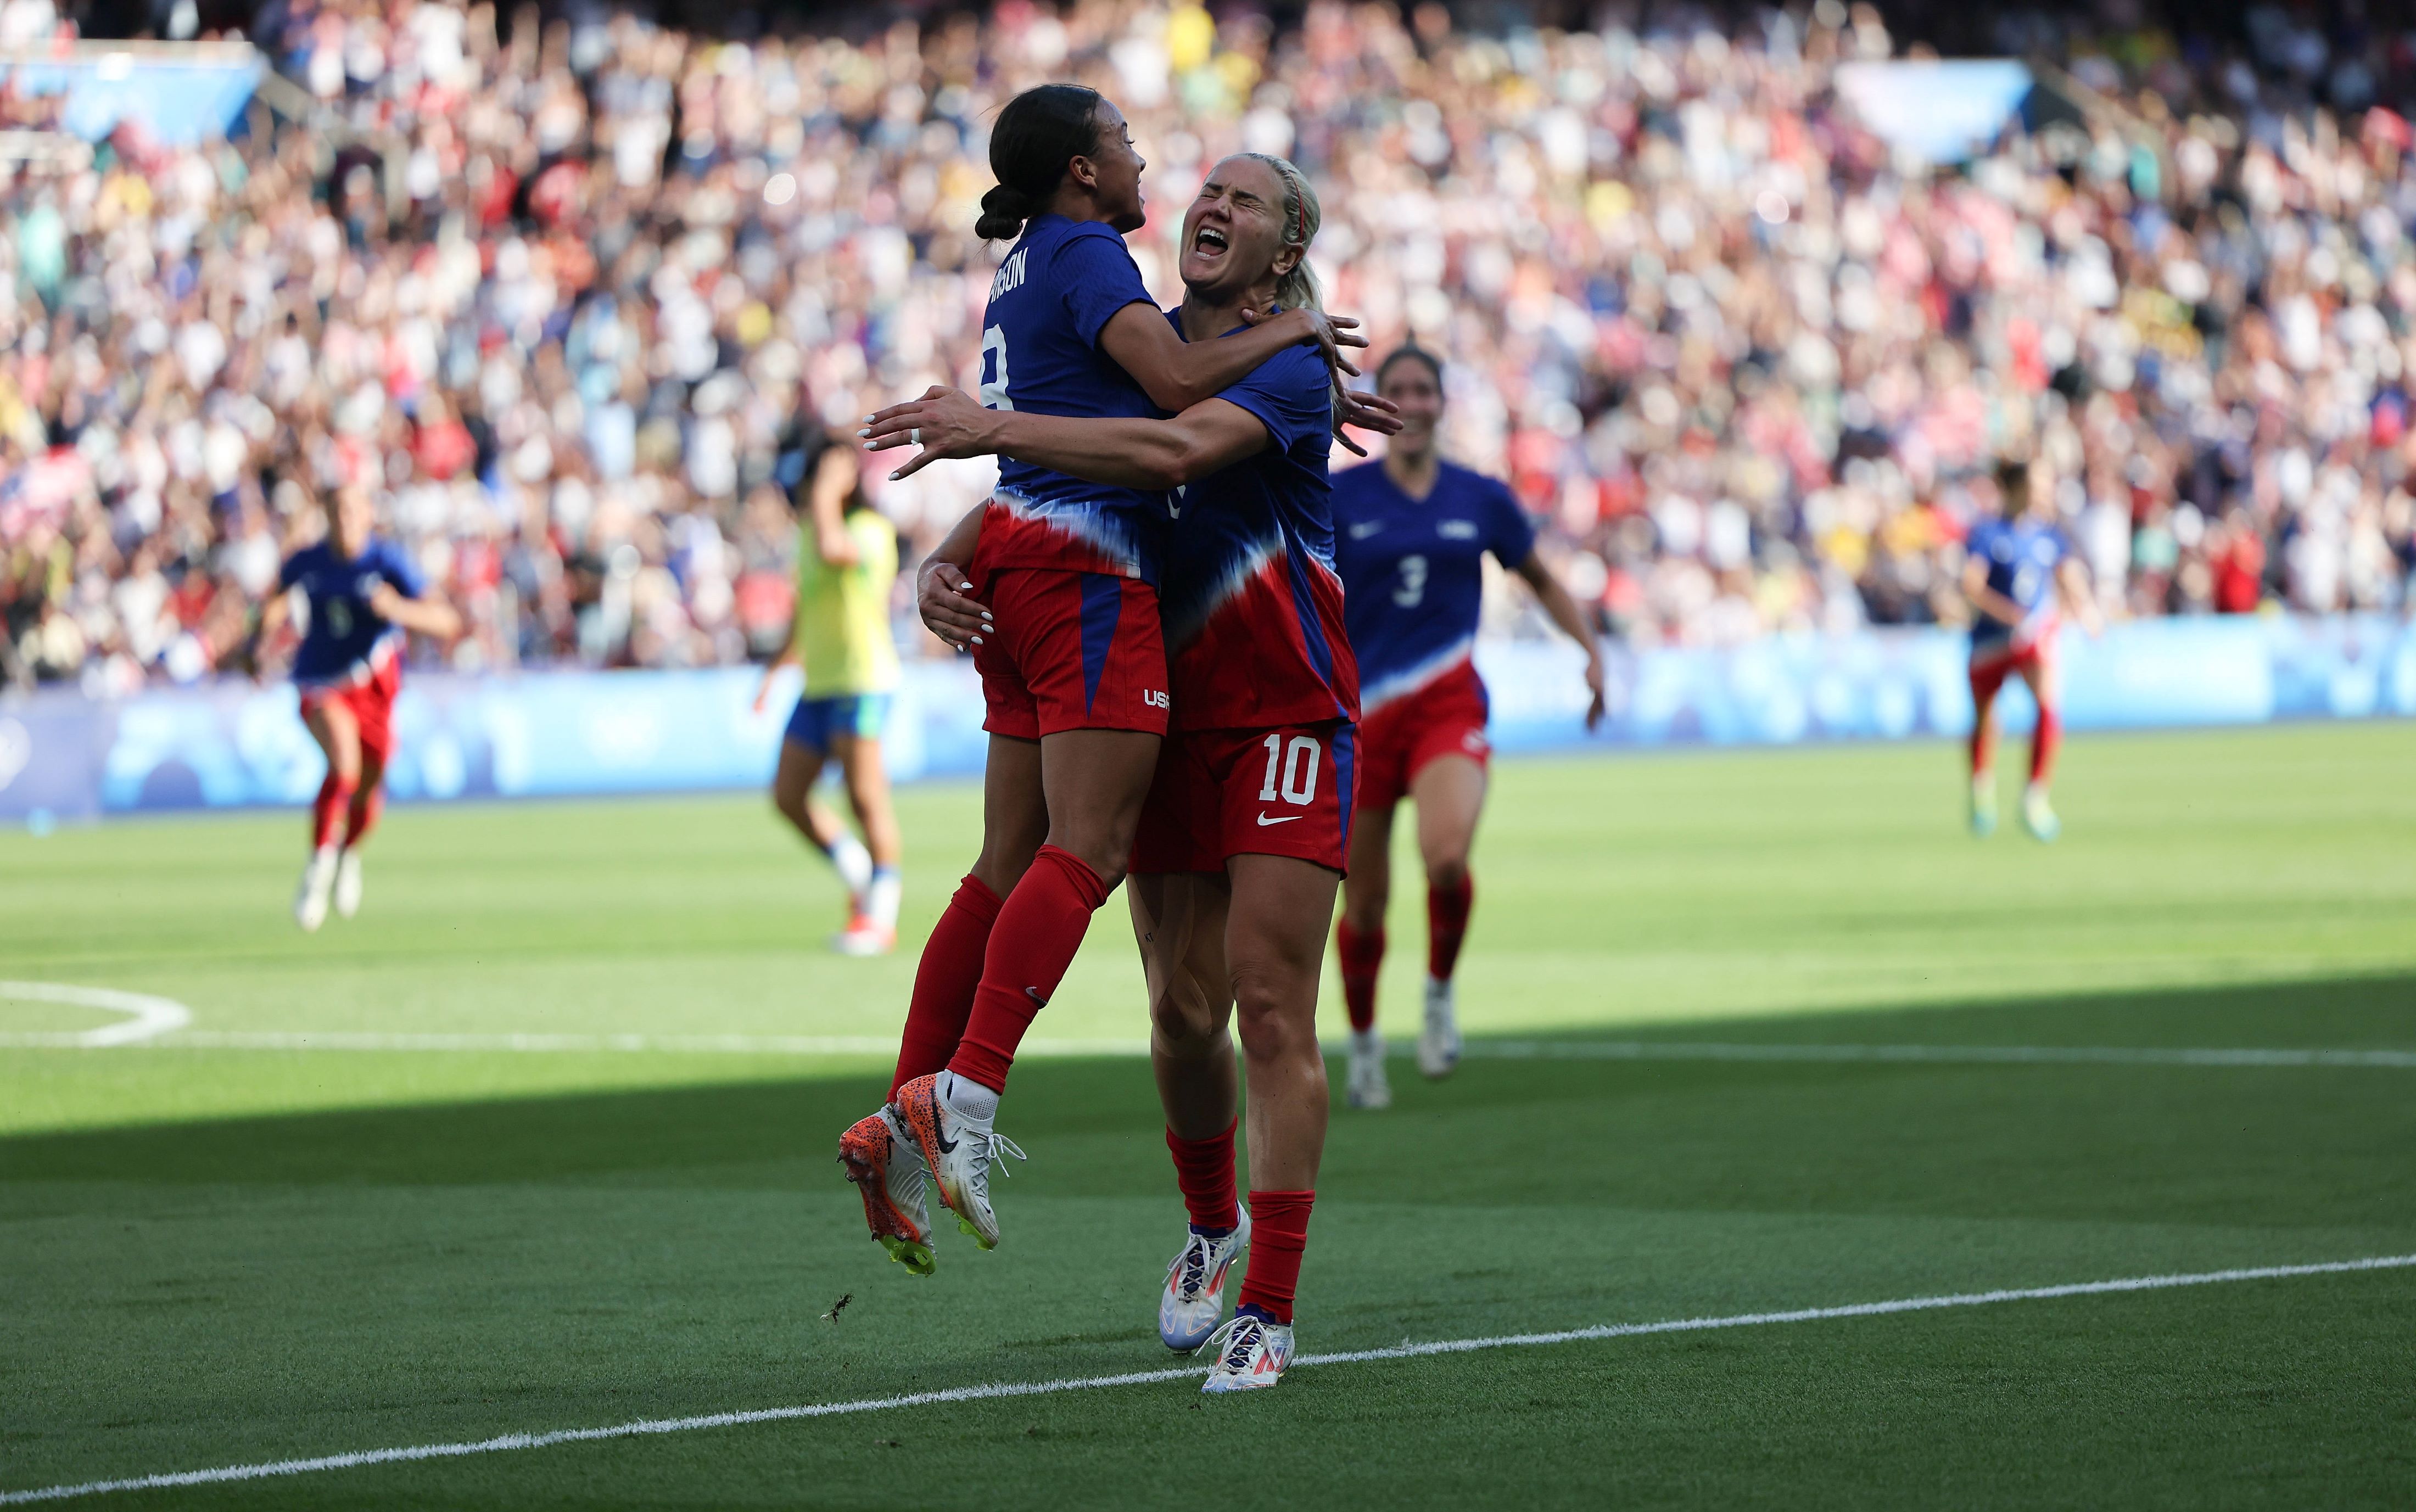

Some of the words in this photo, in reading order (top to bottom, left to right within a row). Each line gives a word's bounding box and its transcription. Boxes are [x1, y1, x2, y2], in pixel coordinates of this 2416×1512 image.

[1392, 555, 1429, 608] 3
[1259, 734, 1321, 805] 10
[1144, 932, 1154, 942] KT
